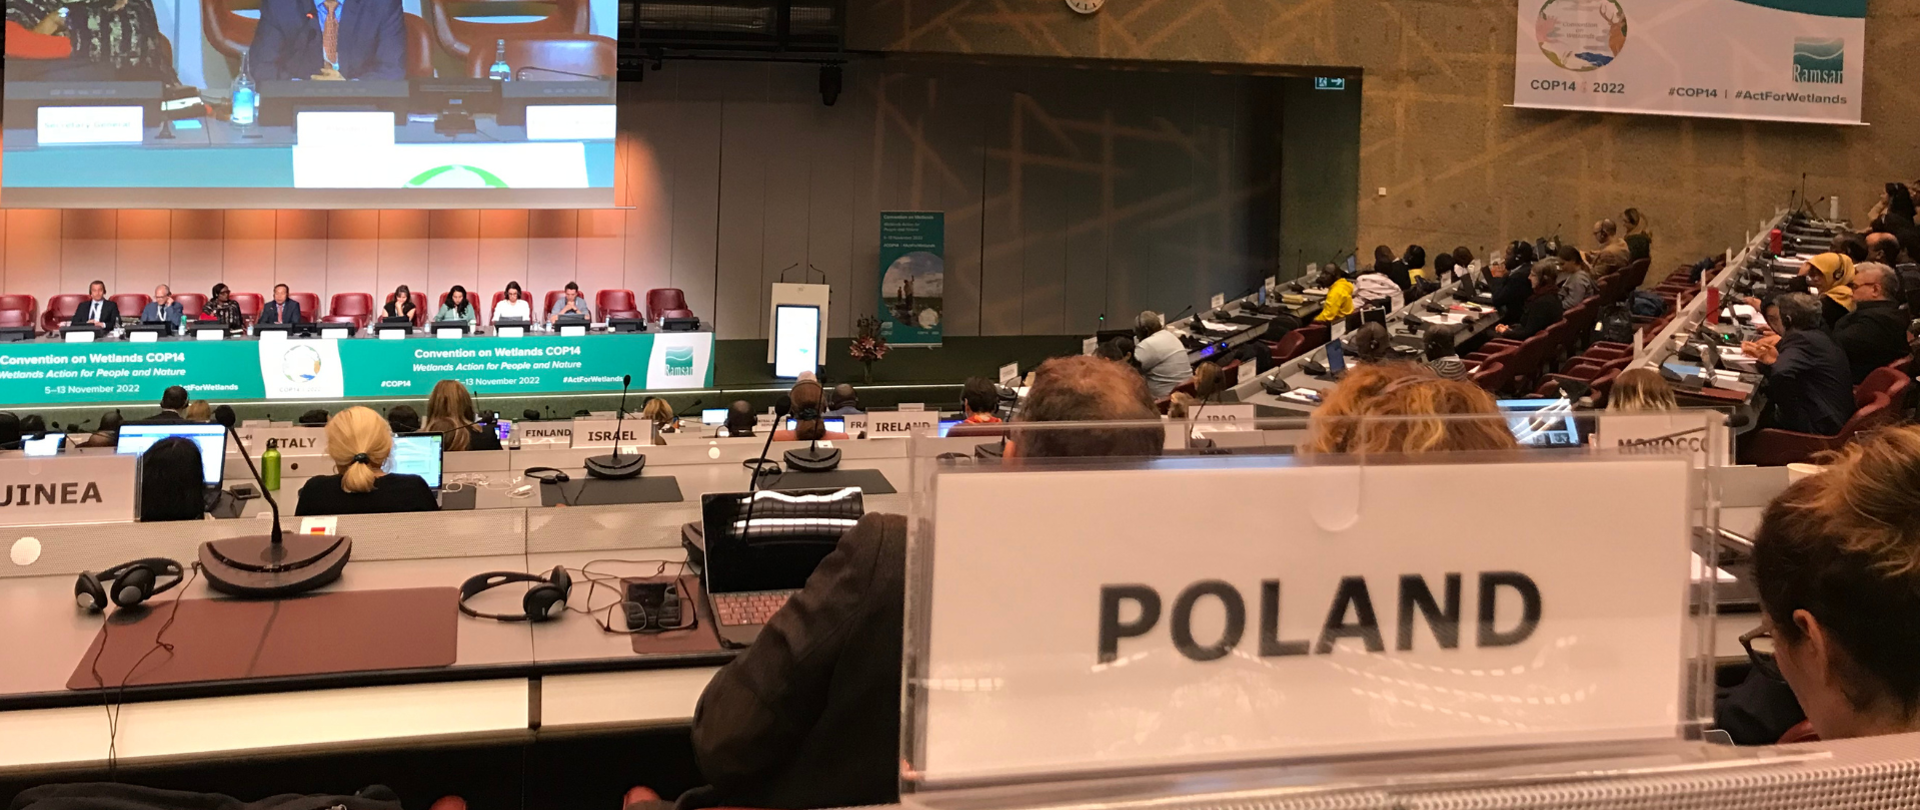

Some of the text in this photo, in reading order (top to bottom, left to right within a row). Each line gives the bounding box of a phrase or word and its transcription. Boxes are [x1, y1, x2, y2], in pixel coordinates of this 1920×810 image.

[1792, 64, 1843, 84] Ramsar
[1531, 80, 1625, 93] COP14 2022
[1668, 87, 1718, 98] #COP14
[1735, 90, 1847, 104] #ActForWetlands
[0, 352, 185, 365] Convention on Wetlands COP14
[414, 348, 476, 359] Convention
[494, 347, 543, 357] Wetlands
[545, 346, 581, 356] COP14
[413, 360, 582, 372] Wetlands Action for People and Nature
[665, 364, 693, 376] Ramsar
[0, 368, 187, 379] Wetlands Action for People and Nature
[562, 375, 624, 383] #ActForWetlands
[381, 380, 411, 388] #COP14
[475, 377, 517, 386] November
[518, 376, 540, 384] 2022
[68, 385, 114, 393] November
[116, 384, 140, 392] 2022
[525, 428, 571, 438] FINLAND
[875, 422, 931, 432] IRELAND
[587, 430, 637, 442] ISRAEL
[1097, 571, 1542, 665] POLAND
